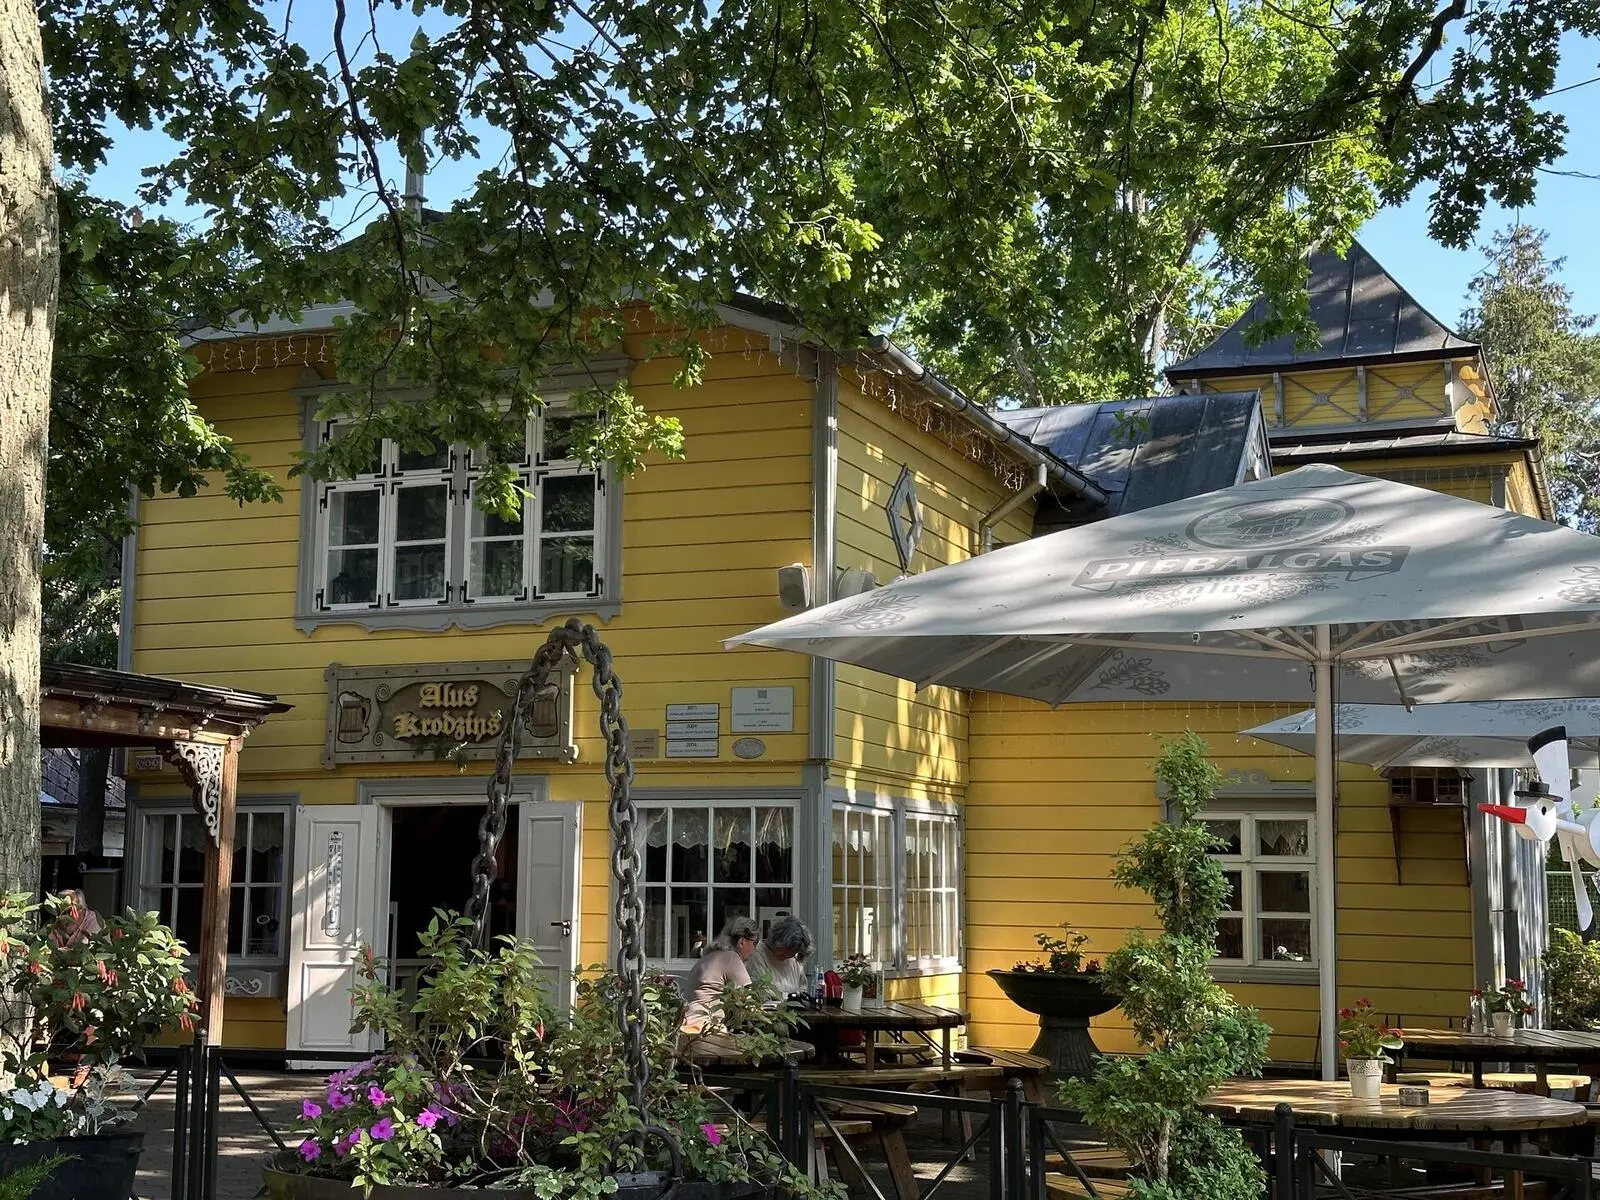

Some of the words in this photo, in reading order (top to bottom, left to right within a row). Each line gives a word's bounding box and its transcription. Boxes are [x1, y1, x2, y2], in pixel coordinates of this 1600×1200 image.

[1090, 550, 1393, 580] PIEBALGAS
[1184, 582, 1262, 595] alus
[419, 683, 479, 708] Alus
[393, 709, 503, 742] Krodziņš
